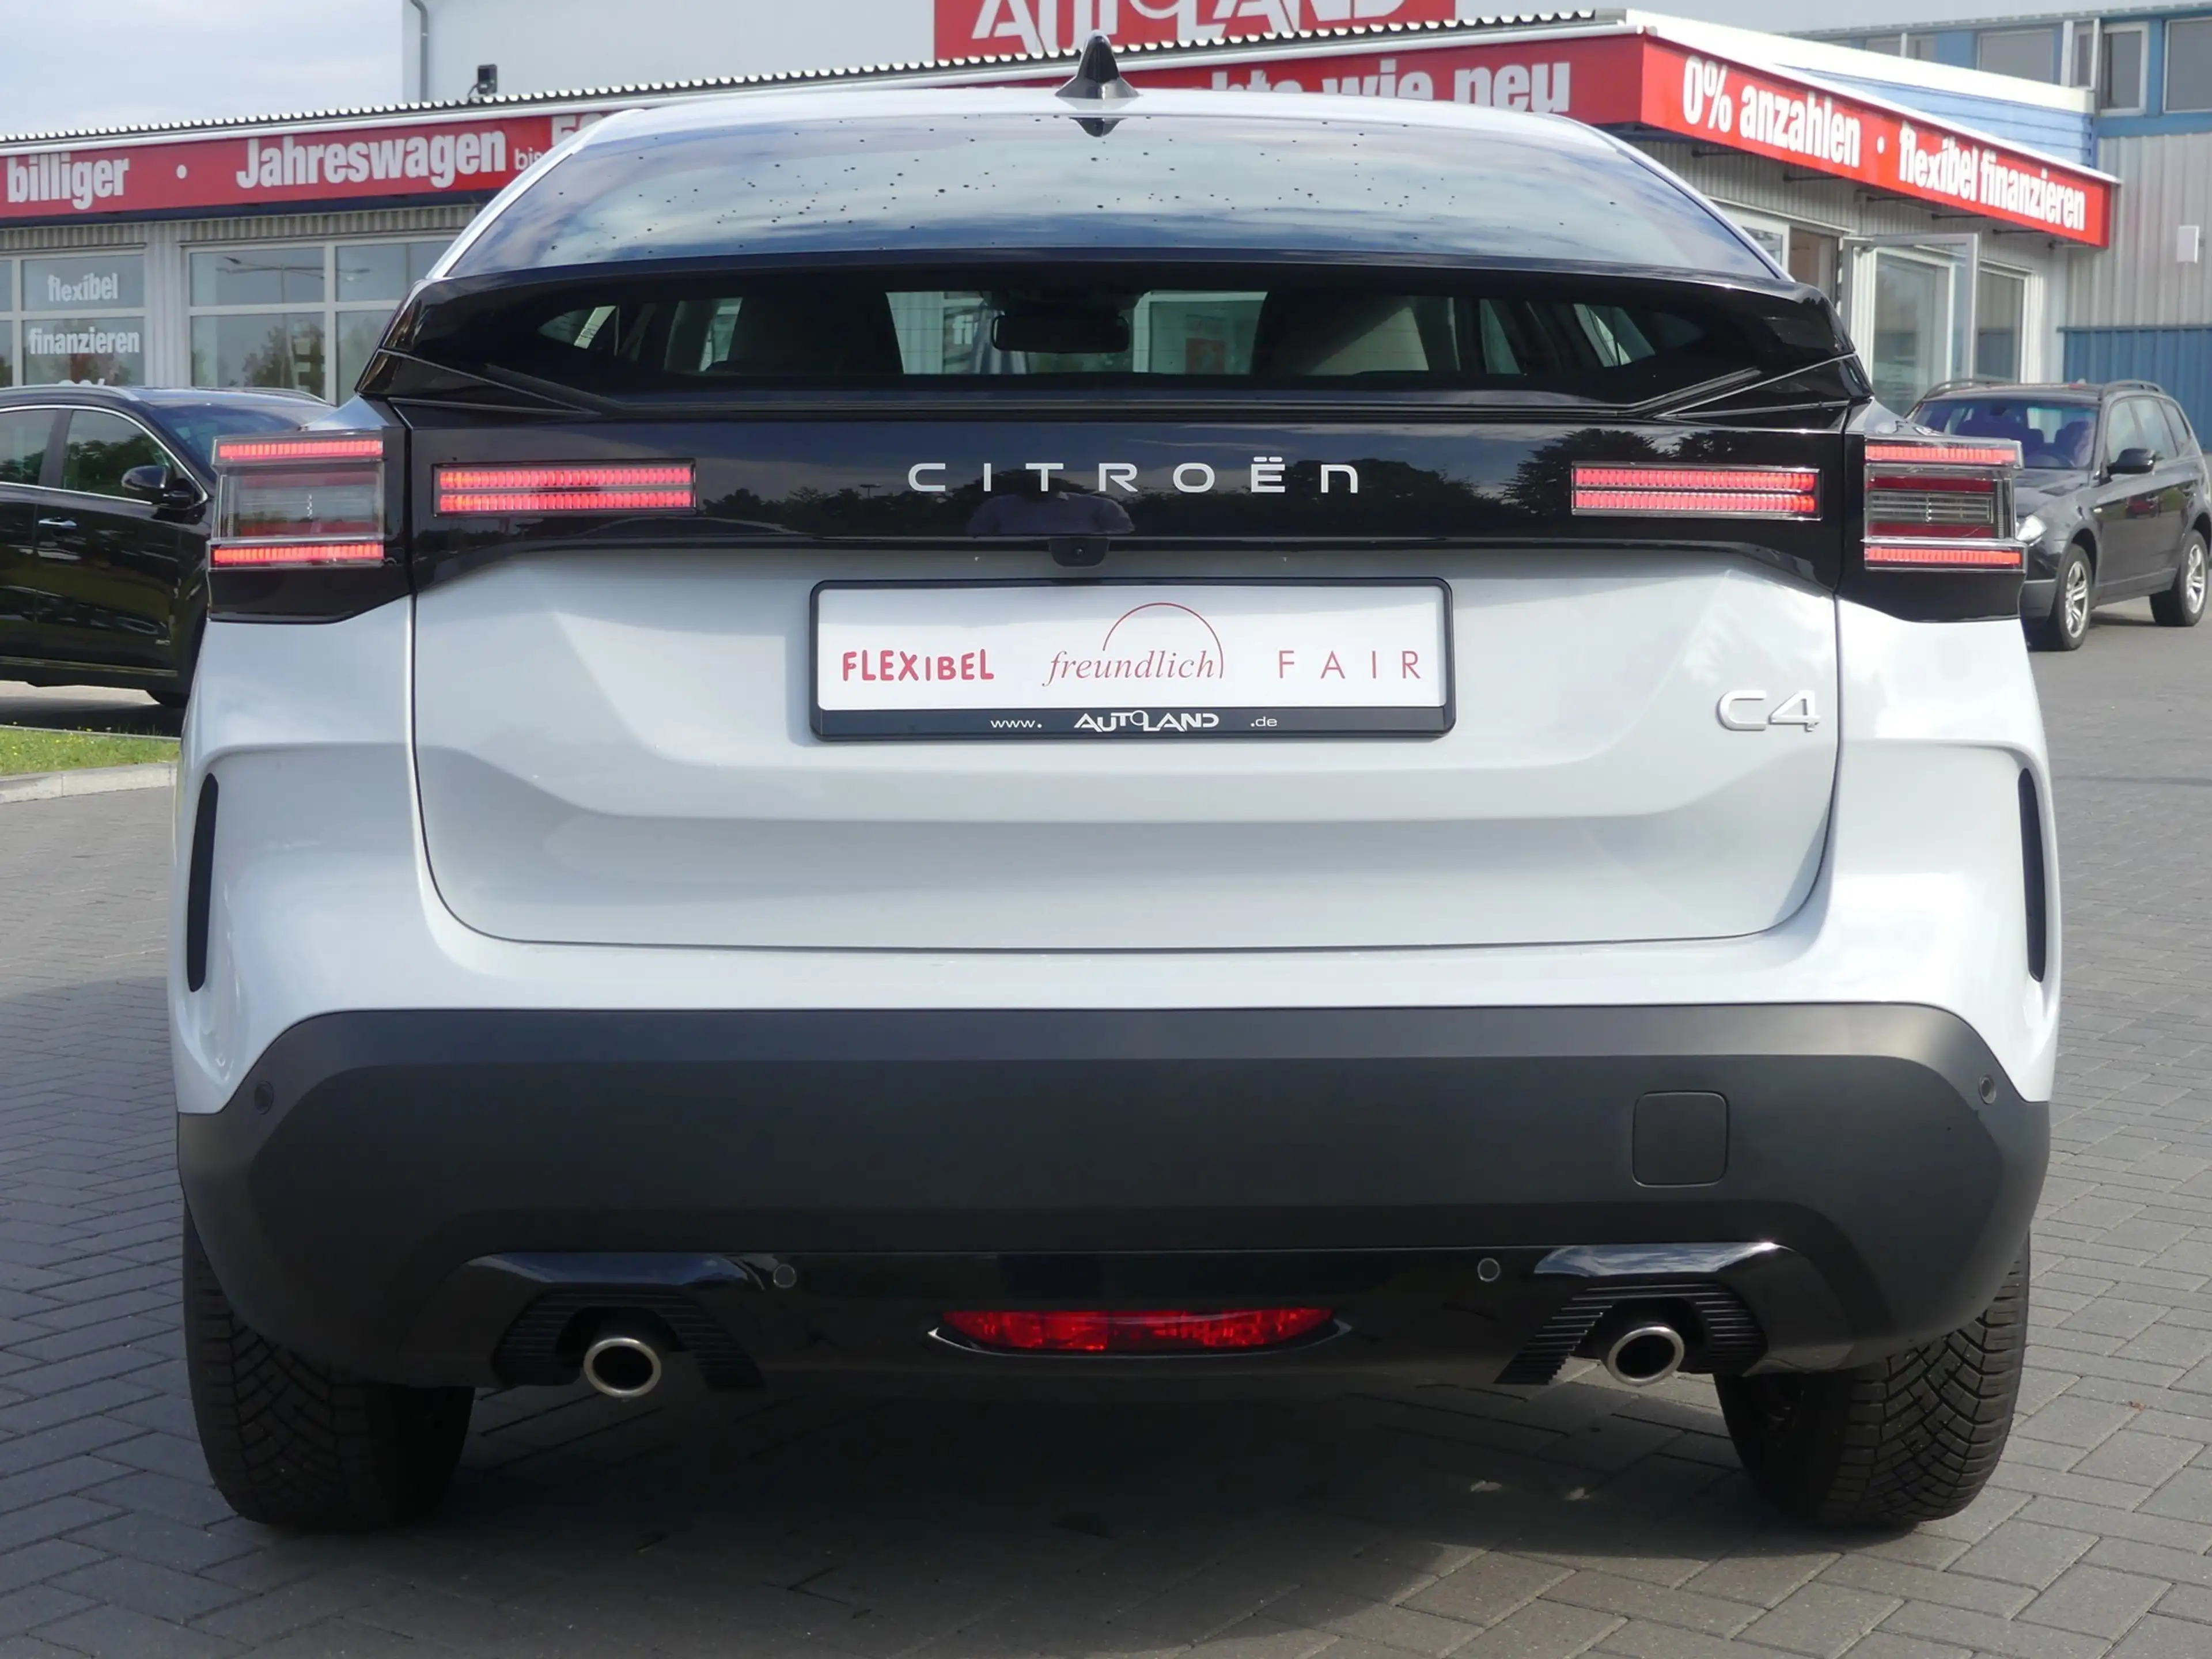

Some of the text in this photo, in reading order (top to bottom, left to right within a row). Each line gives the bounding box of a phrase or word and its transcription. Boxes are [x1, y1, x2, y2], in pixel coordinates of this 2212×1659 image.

[1455, 62, 1571, 113] neu
[1683, 55, 2086, 231] 0% anzahlen flexibel finanzieren
[7, 152, 130, 210] billiger
[236, 130, 507, 189] Jahreswagen
[47, 273, 119, 302] flexibel
[29, 326, 140, 355] finanzieren
[843, 649, 1422, 687] FLEXIBEL freundlich FAIR
[1073, 710, 1219, 732] AUTOLAND
[1715, 690, 1821, 733] C4
